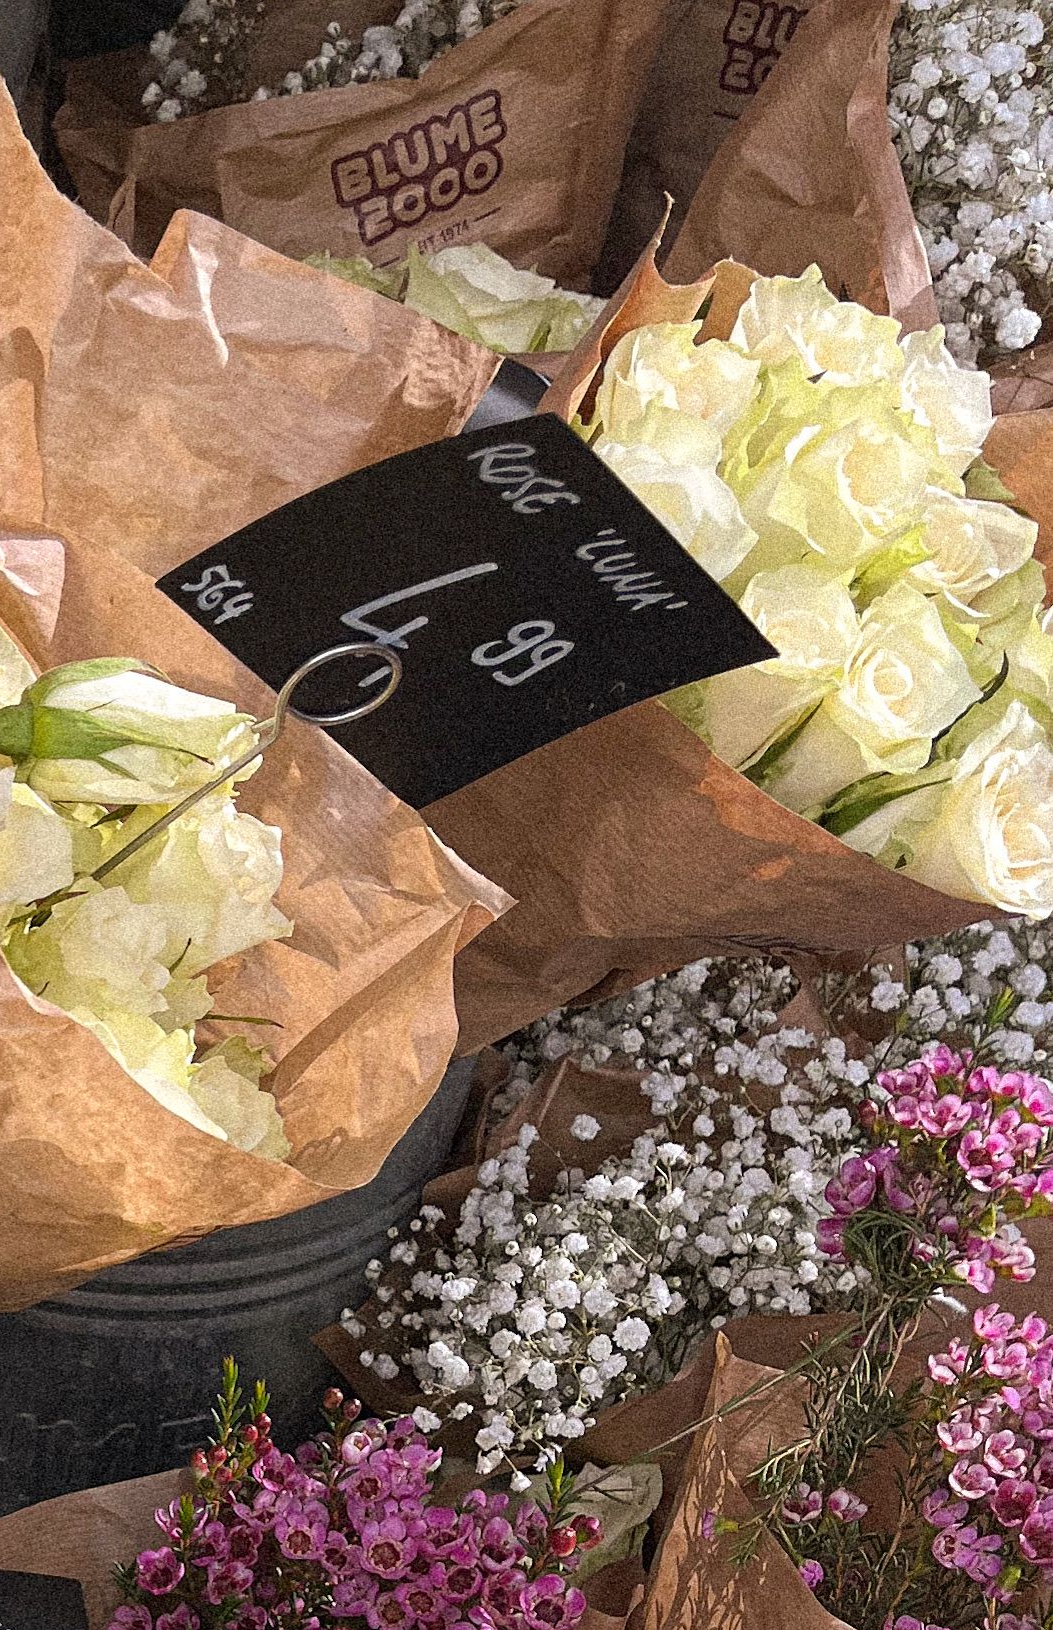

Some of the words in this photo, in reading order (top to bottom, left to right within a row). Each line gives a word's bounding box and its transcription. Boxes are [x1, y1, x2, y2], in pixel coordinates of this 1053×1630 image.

[331, 89, 507, 208] BLUME
[354, 145, 503, 246] 2000
[467, 443, 581, 514] ROSE
[181, 564, 254, 625] 564
